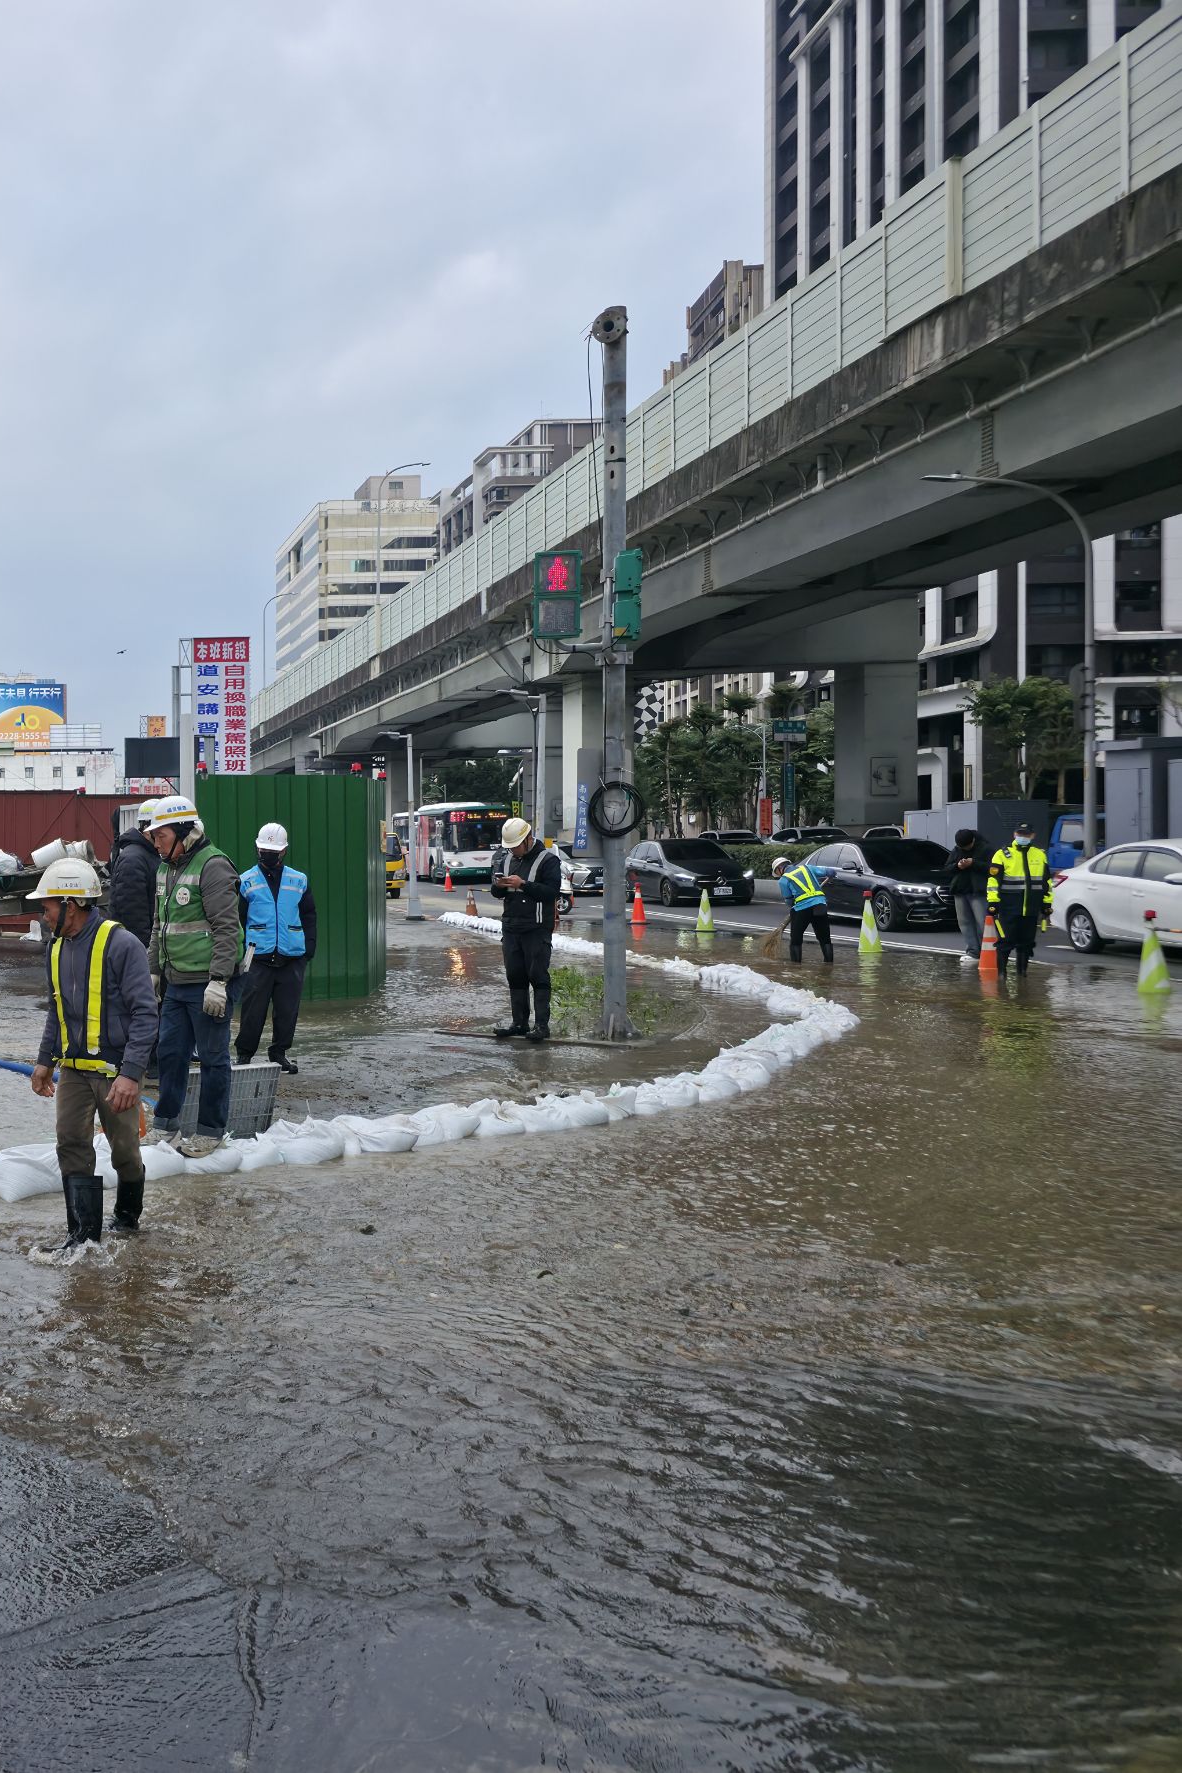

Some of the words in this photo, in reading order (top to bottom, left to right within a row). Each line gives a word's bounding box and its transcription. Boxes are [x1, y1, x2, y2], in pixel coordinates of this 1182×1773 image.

[196, 641, 247, 660] 本班新設
[224, 664, 247, 772] 自用換職業駕照班
